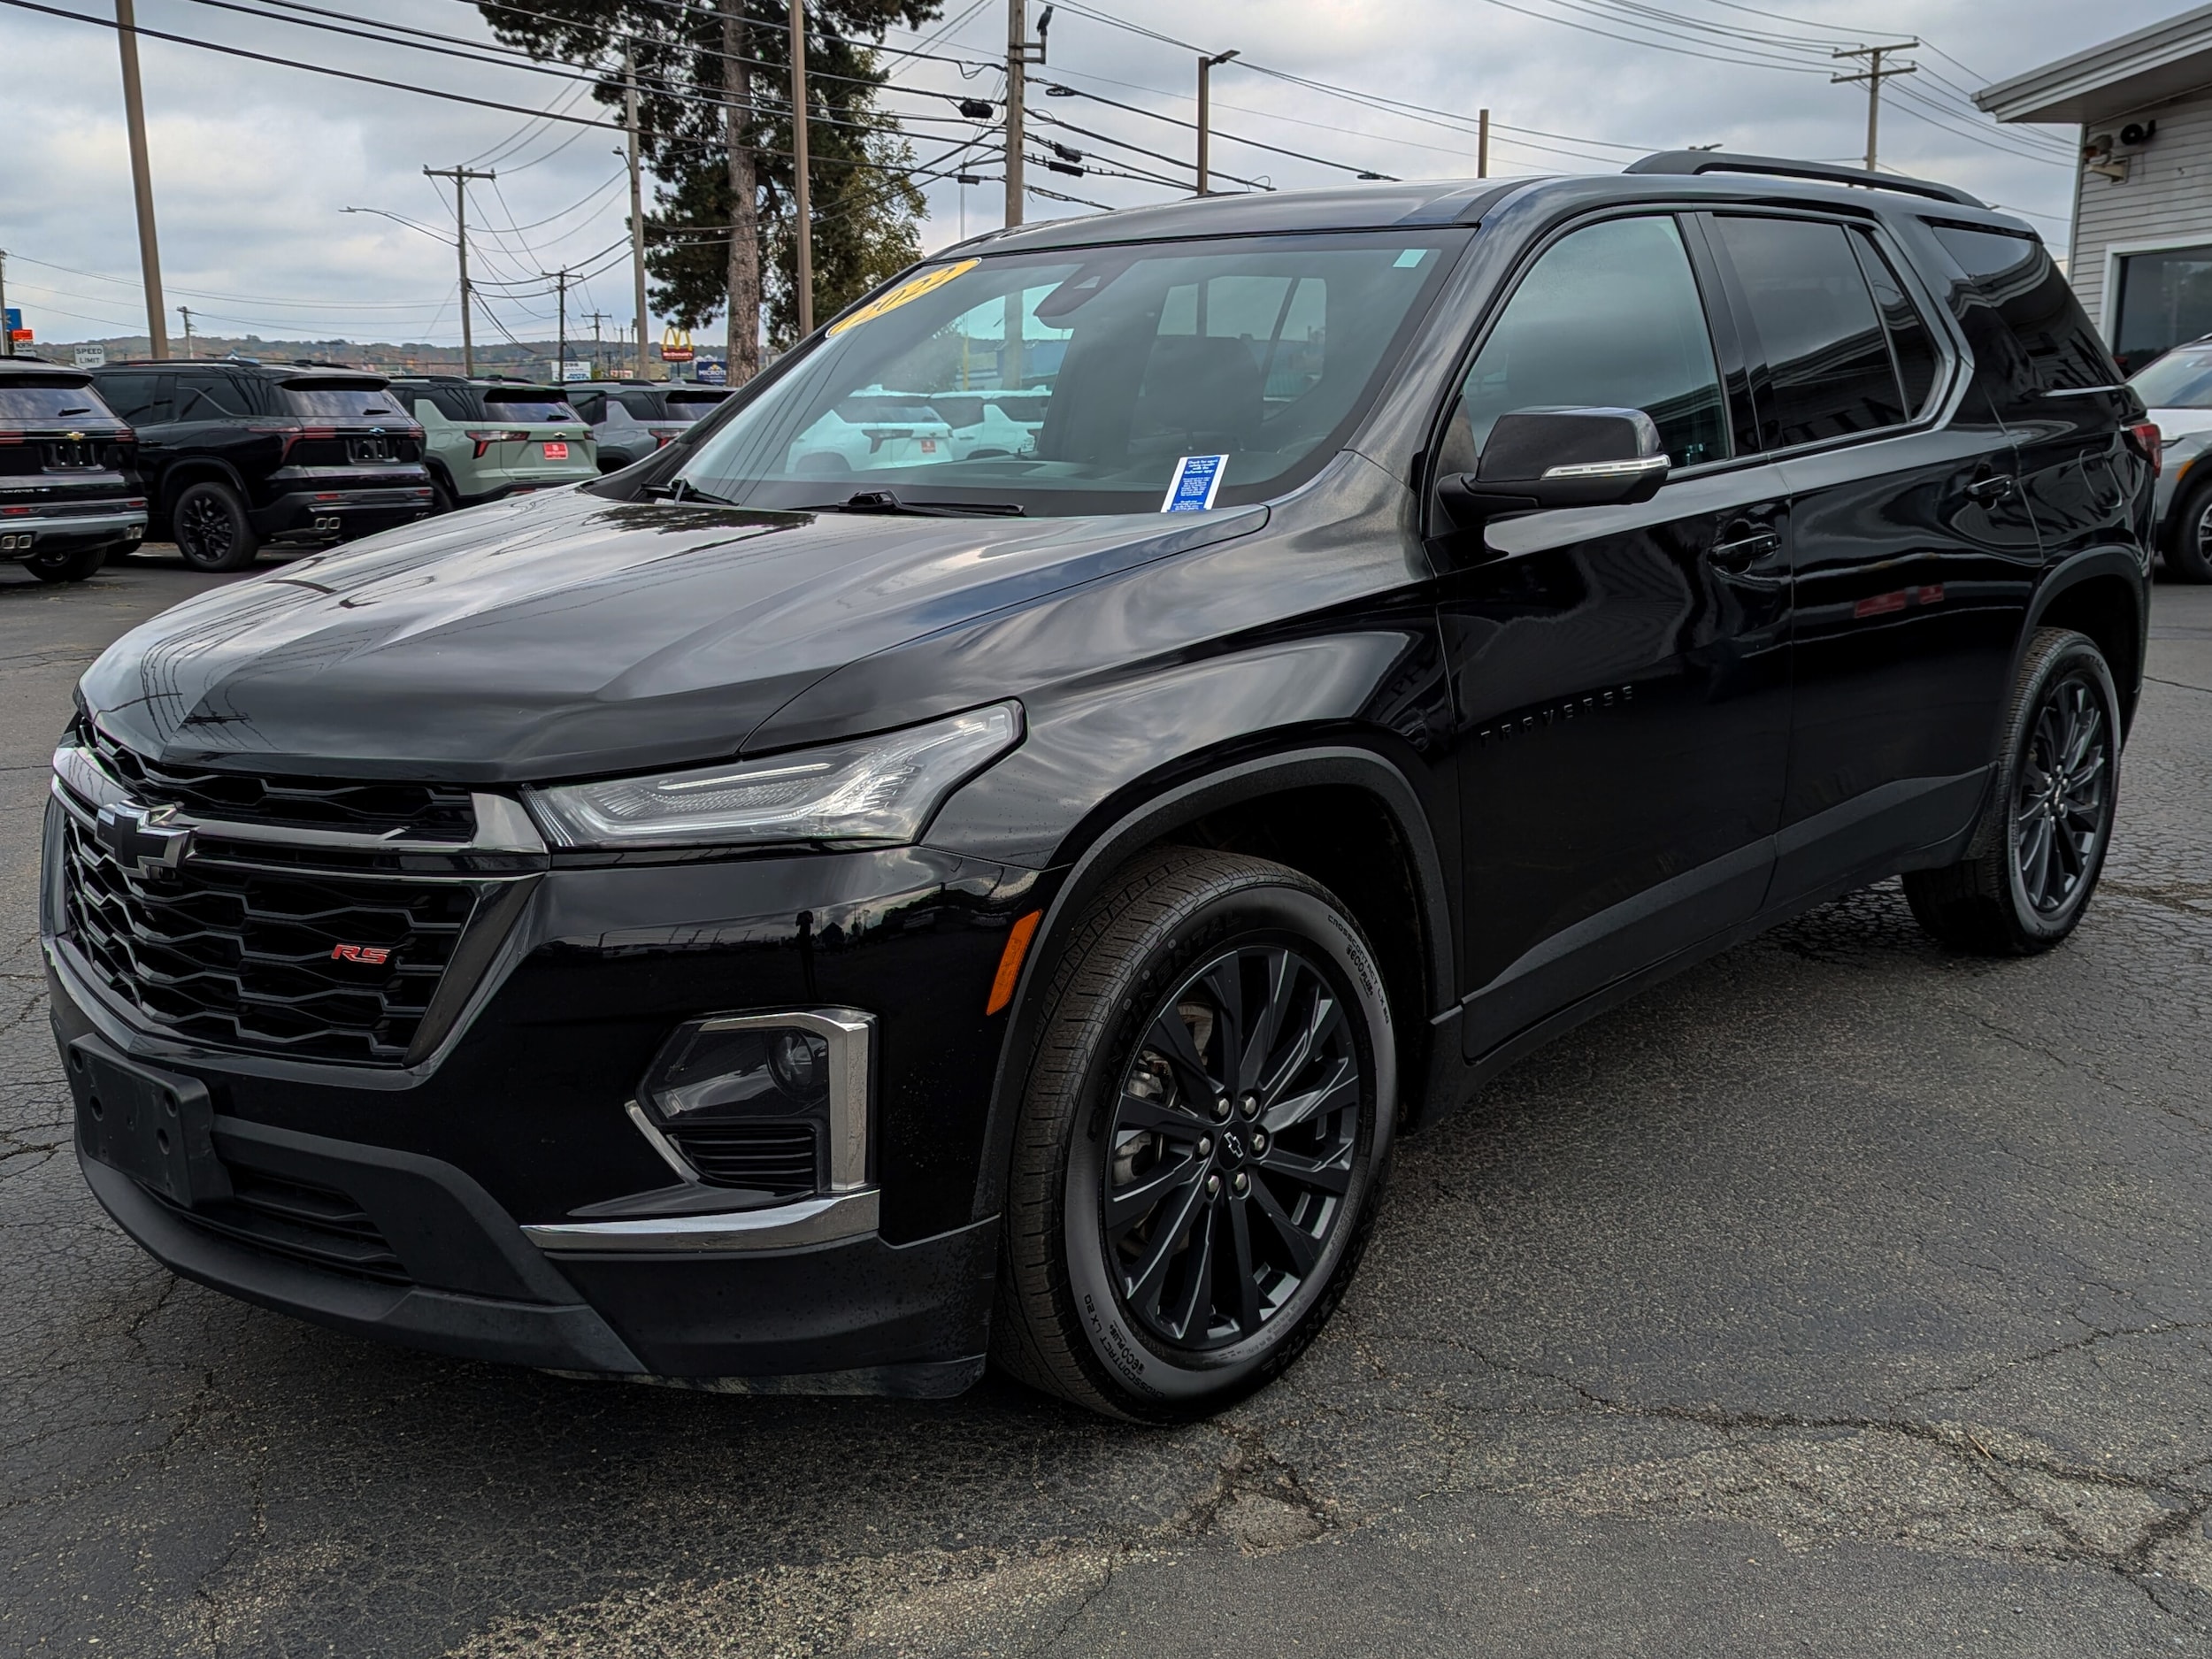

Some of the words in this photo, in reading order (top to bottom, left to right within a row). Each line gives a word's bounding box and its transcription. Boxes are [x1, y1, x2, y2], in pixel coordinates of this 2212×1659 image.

[1480, 685, 1634, 749] TRAVERSE
[331, 943, 392, 965] RS
[1328, 914, 1379, 985] CROSSCONTACT
[1100, 1336, 1166, 1400] CROSSCONTACT
